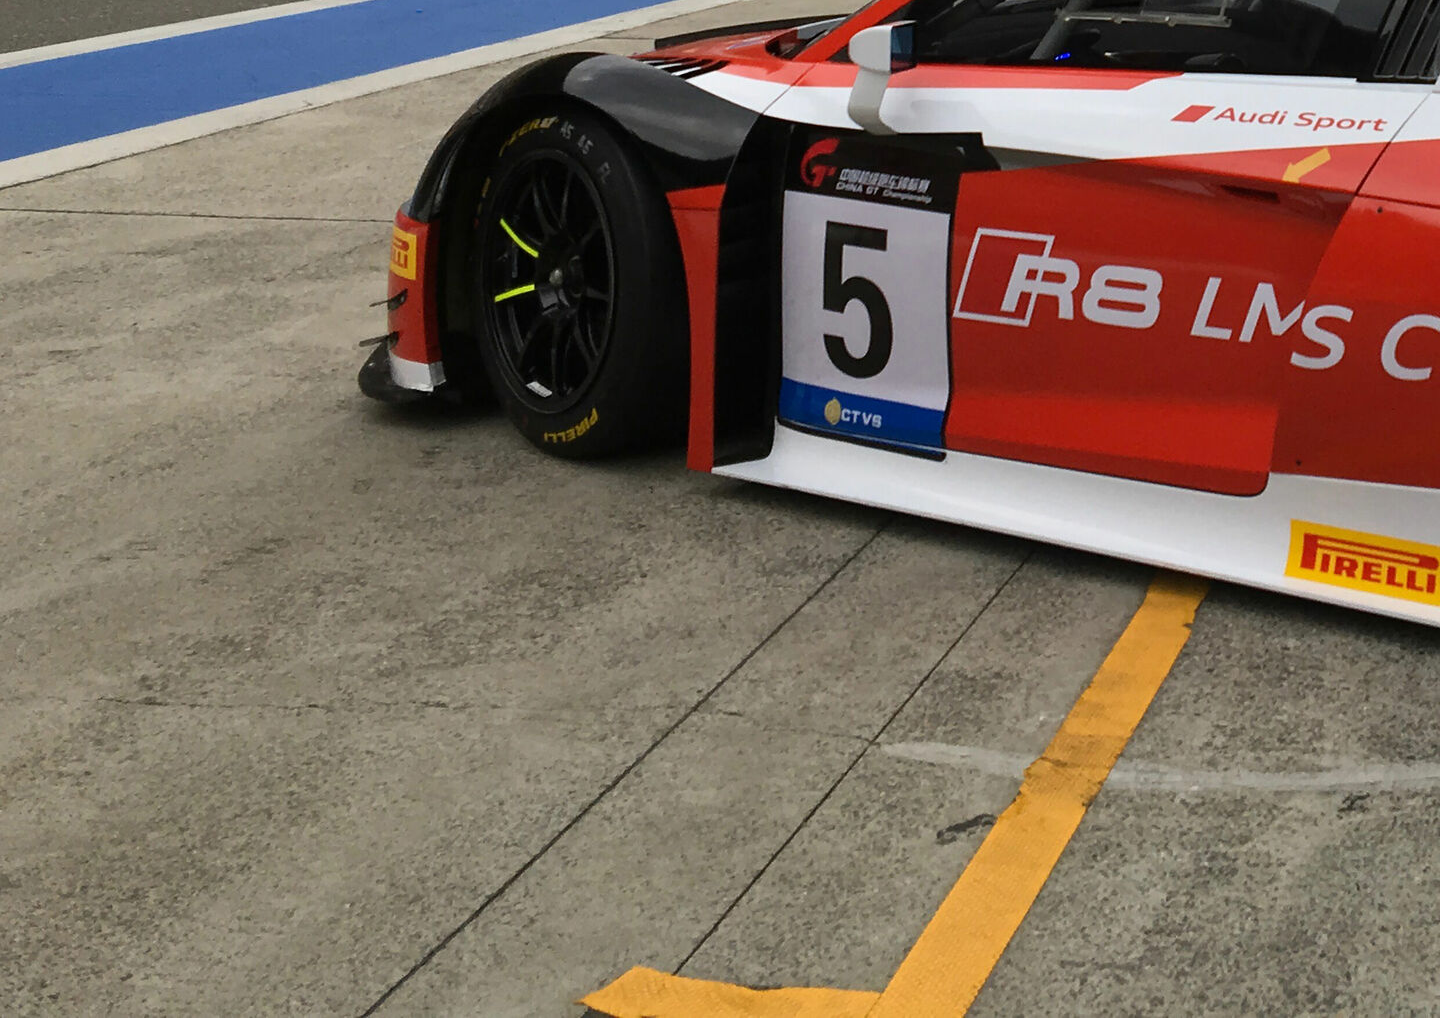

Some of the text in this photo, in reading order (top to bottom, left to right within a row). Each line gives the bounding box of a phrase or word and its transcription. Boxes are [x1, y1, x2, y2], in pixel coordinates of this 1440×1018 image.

[1213, 106, 1387, 133] Audi Sport
[823, 220, 894, 379] 5
[1001, 250, 1164, 330] R8
[1190, 276, 1355, 371] LMS
[543, 407, 599, 444] PIRELLI
[1300, 532, 1440, 595] PIRELLI
